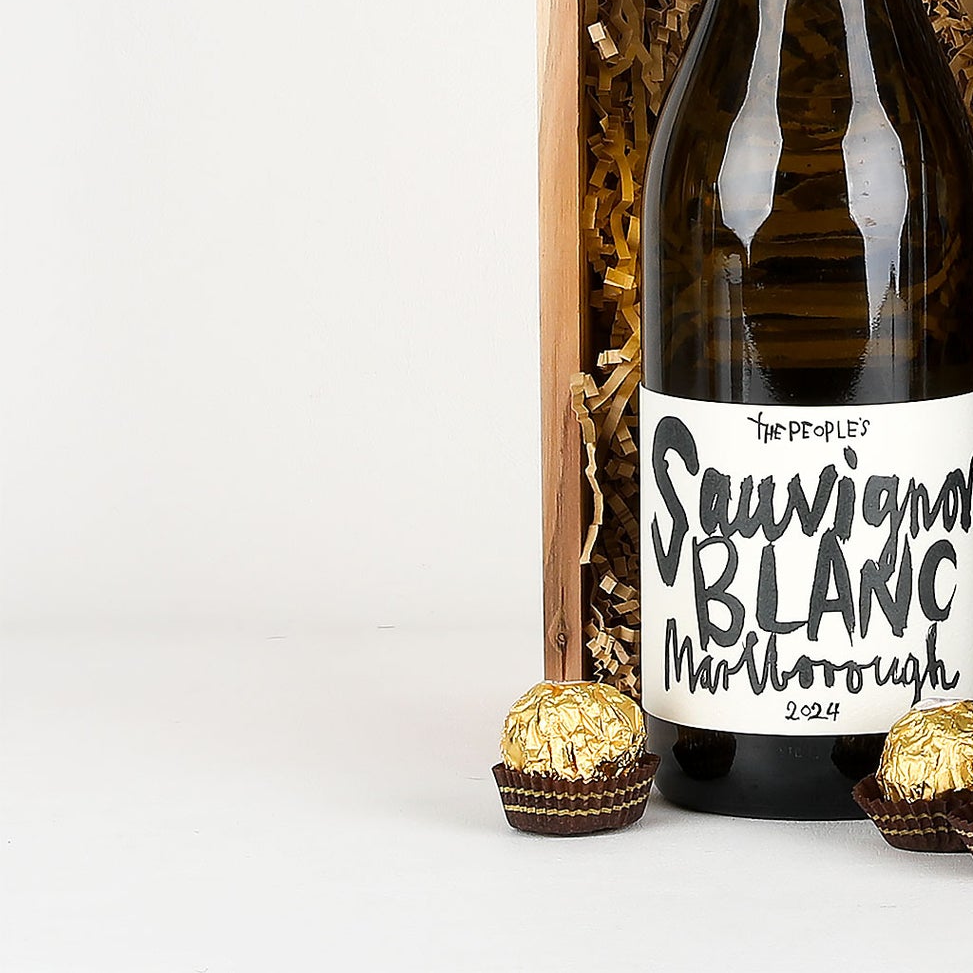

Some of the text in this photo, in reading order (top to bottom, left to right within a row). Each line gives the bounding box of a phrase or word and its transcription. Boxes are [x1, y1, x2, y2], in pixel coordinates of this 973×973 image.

[747, 412, 870, 444] THE PEOPLE'S
[692, 528, 958, 651] BLANC
[664, 618, 960, 709] Marlborough
[784, 701, 840, 721] 2024
